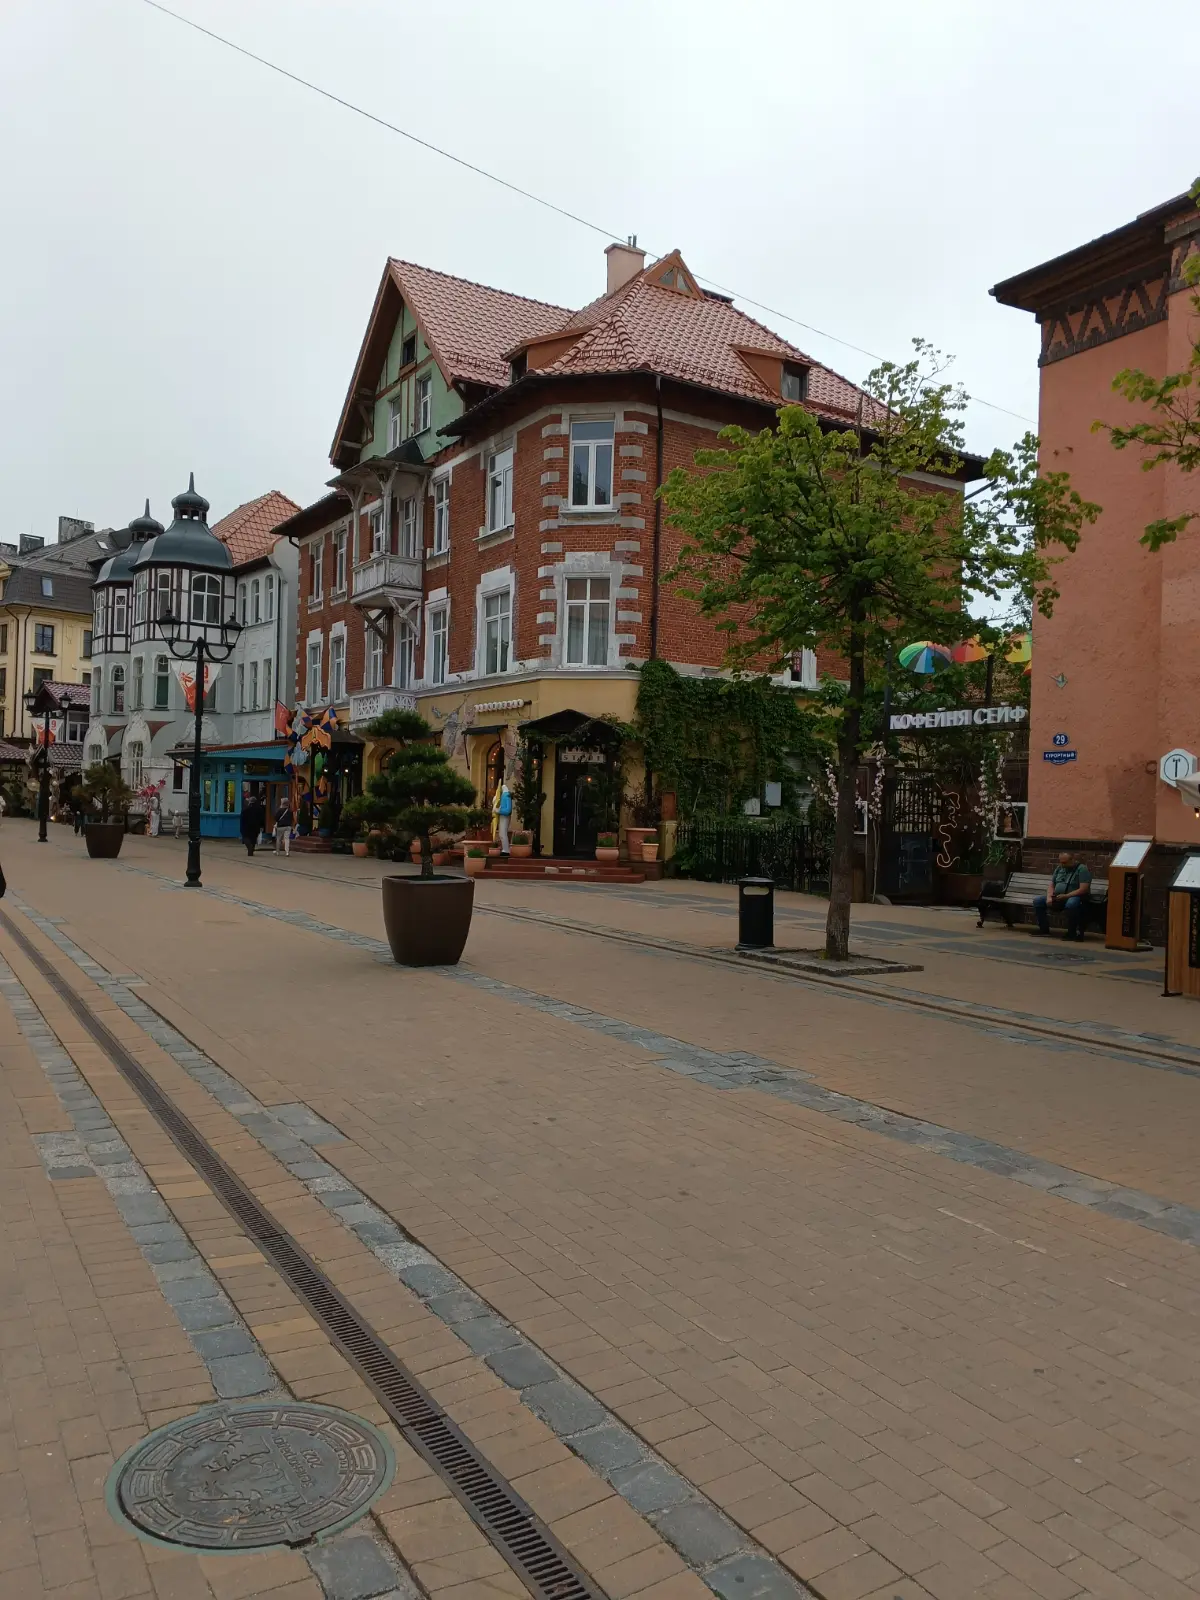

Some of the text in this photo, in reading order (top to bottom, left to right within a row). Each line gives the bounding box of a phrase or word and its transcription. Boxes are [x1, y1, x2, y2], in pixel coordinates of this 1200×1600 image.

[51, 719, 57, 728] 9
[889, 702, 1029, 730] КОФЕЙНЯ СЕЙФ
[1056, 736, 1065, 745] 29
[300, 1447, 325, 1470] 2021
